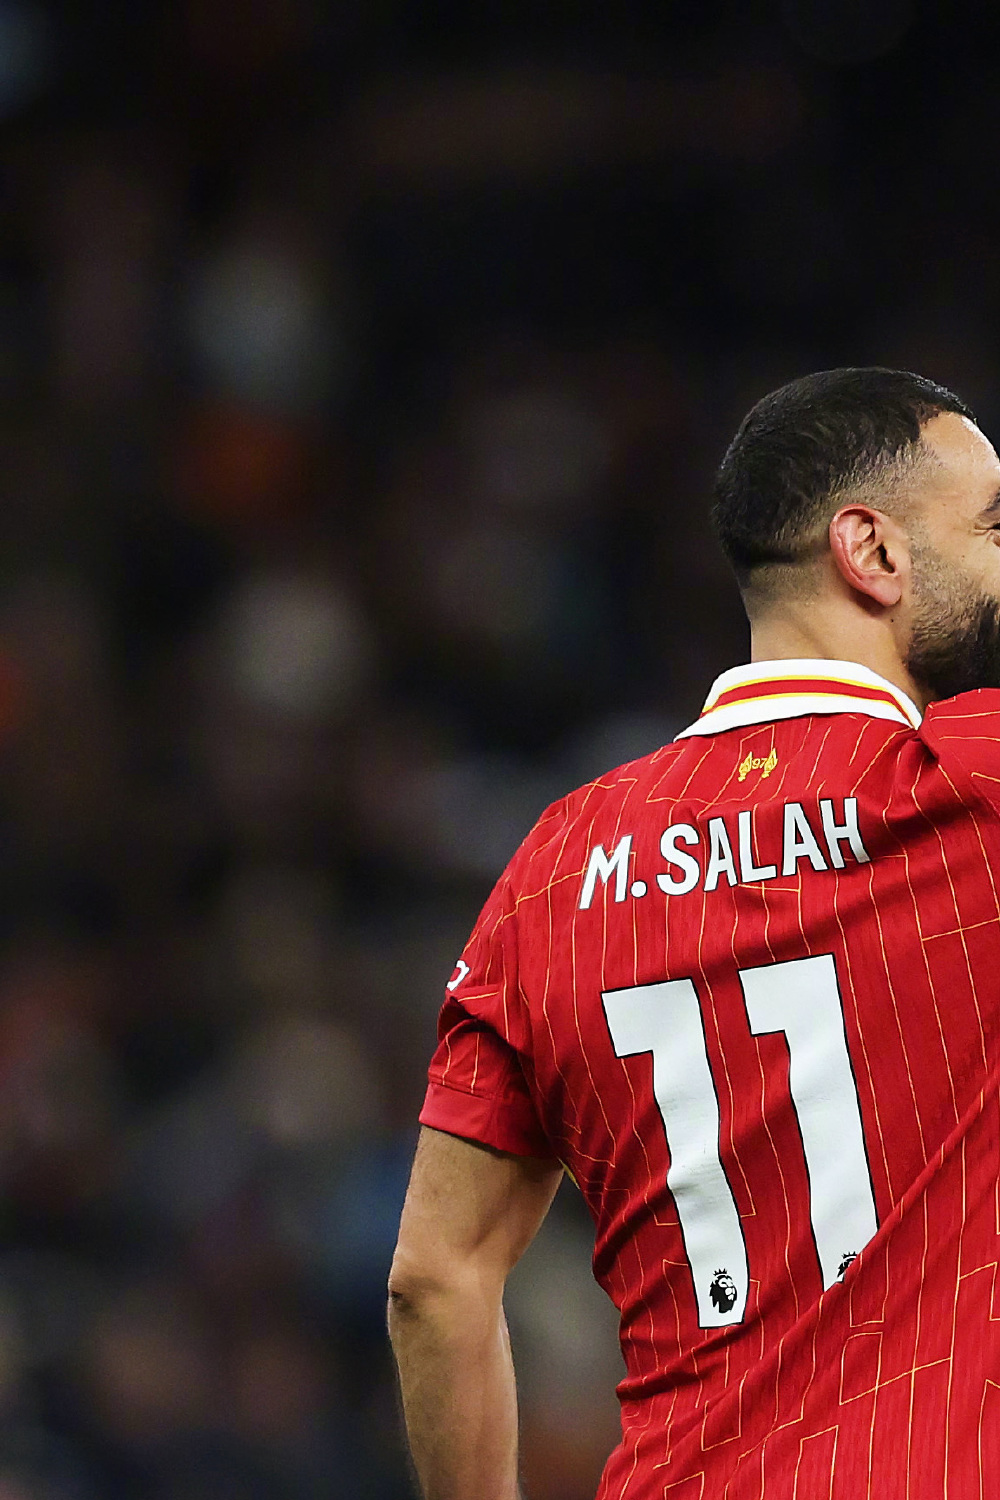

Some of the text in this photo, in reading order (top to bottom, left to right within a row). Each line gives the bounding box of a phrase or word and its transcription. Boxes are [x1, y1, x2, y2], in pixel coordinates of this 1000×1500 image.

[752, 757, 768, 769] 97
[578, 797, 872, 910] M. SALAH
[601, 953, 881, 1329] 11
